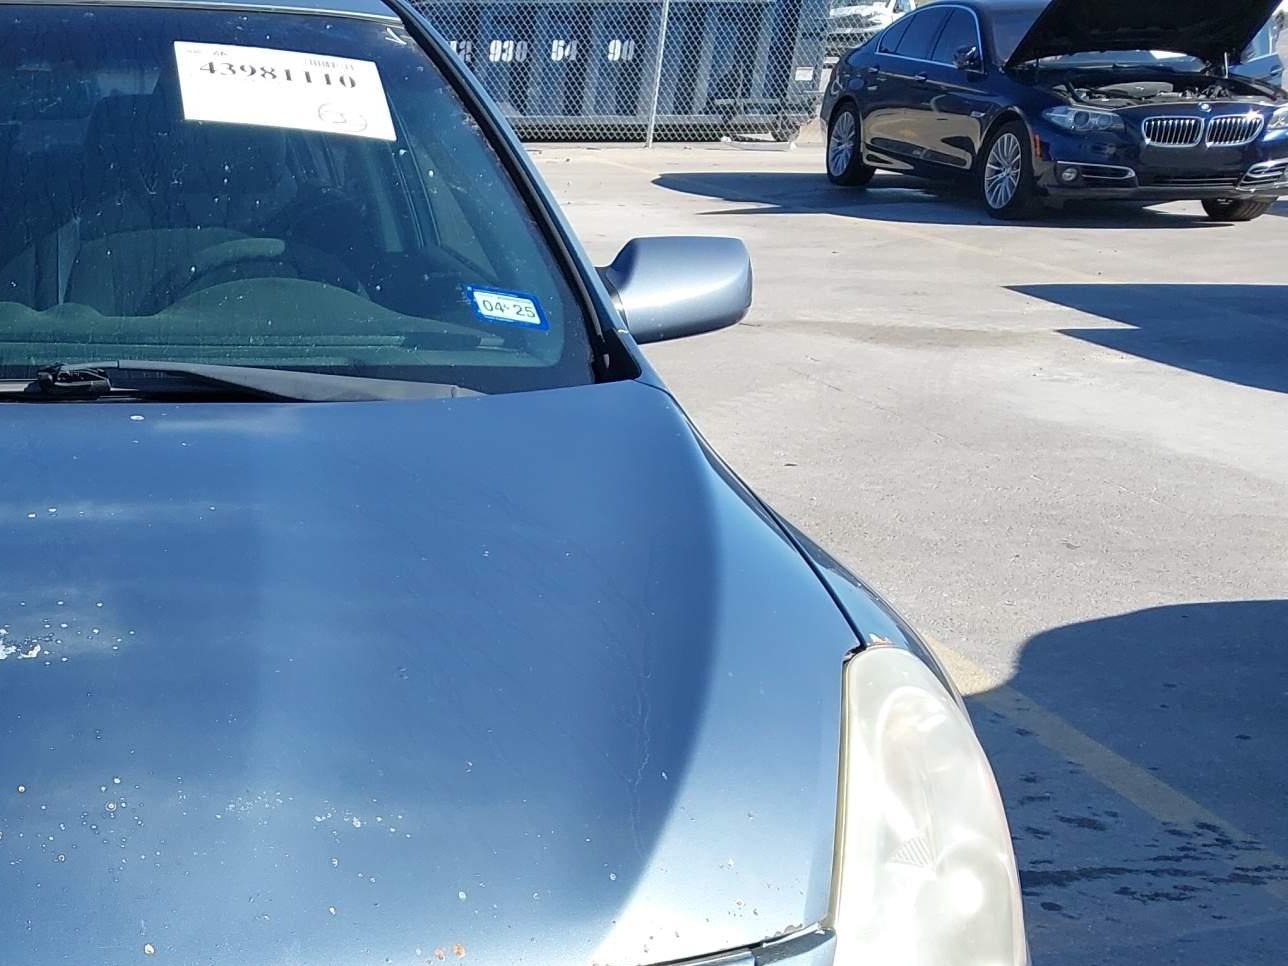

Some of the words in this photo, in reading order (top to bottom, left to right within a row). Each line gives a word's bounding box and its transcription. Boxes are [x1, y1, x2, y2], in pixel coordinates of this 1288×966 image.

[488, 39, 528, 62] 930
[551, 39, 578, 61] 54
[607, 39, 635, 61] 90
[199, 60, 357, 89] 43981110
